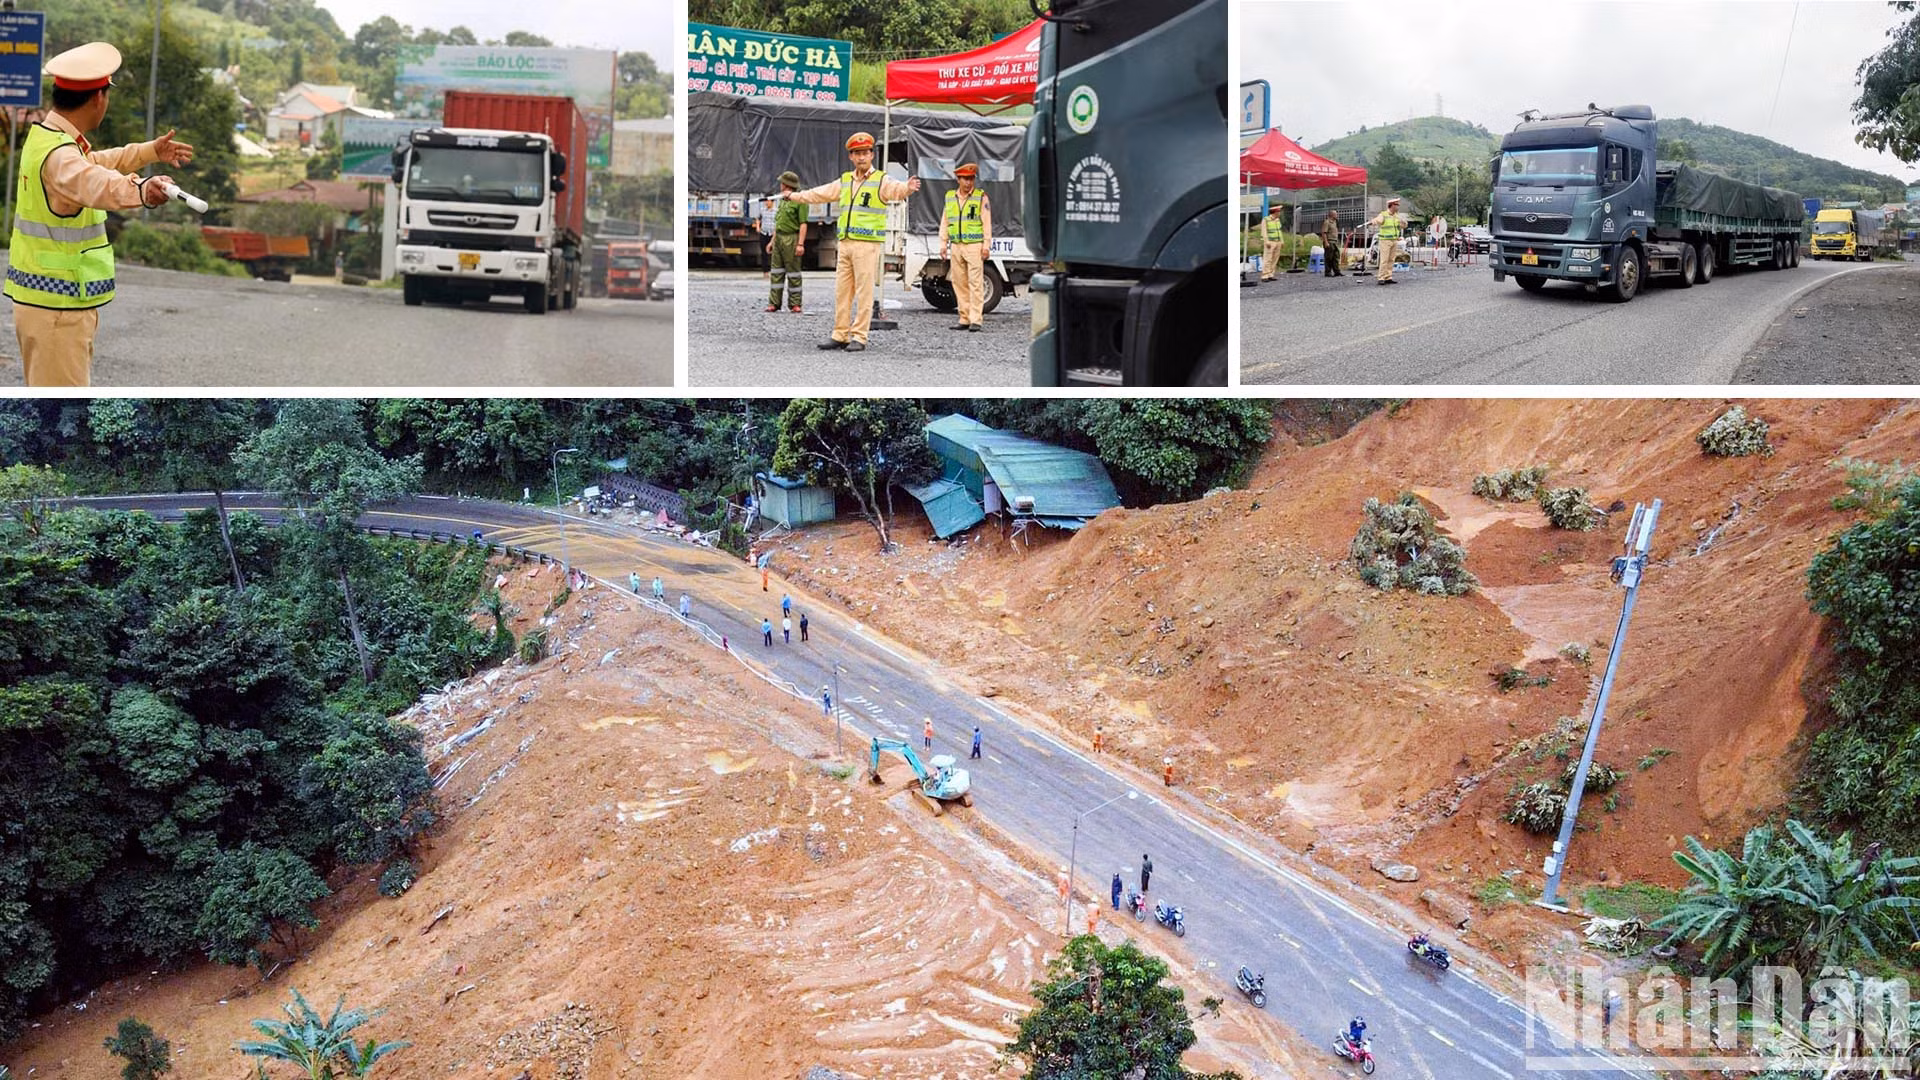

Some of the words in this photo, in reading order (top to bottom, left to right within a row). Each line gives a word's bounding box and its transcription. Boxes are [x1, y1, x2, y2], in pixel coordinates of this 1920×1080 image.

[744, 38, 800, 64] ĐỨC
[805, 45, 842, 69] HÀ
[958, 67, 970, 78] XE
[1010, 63, 1022, 74] XE
